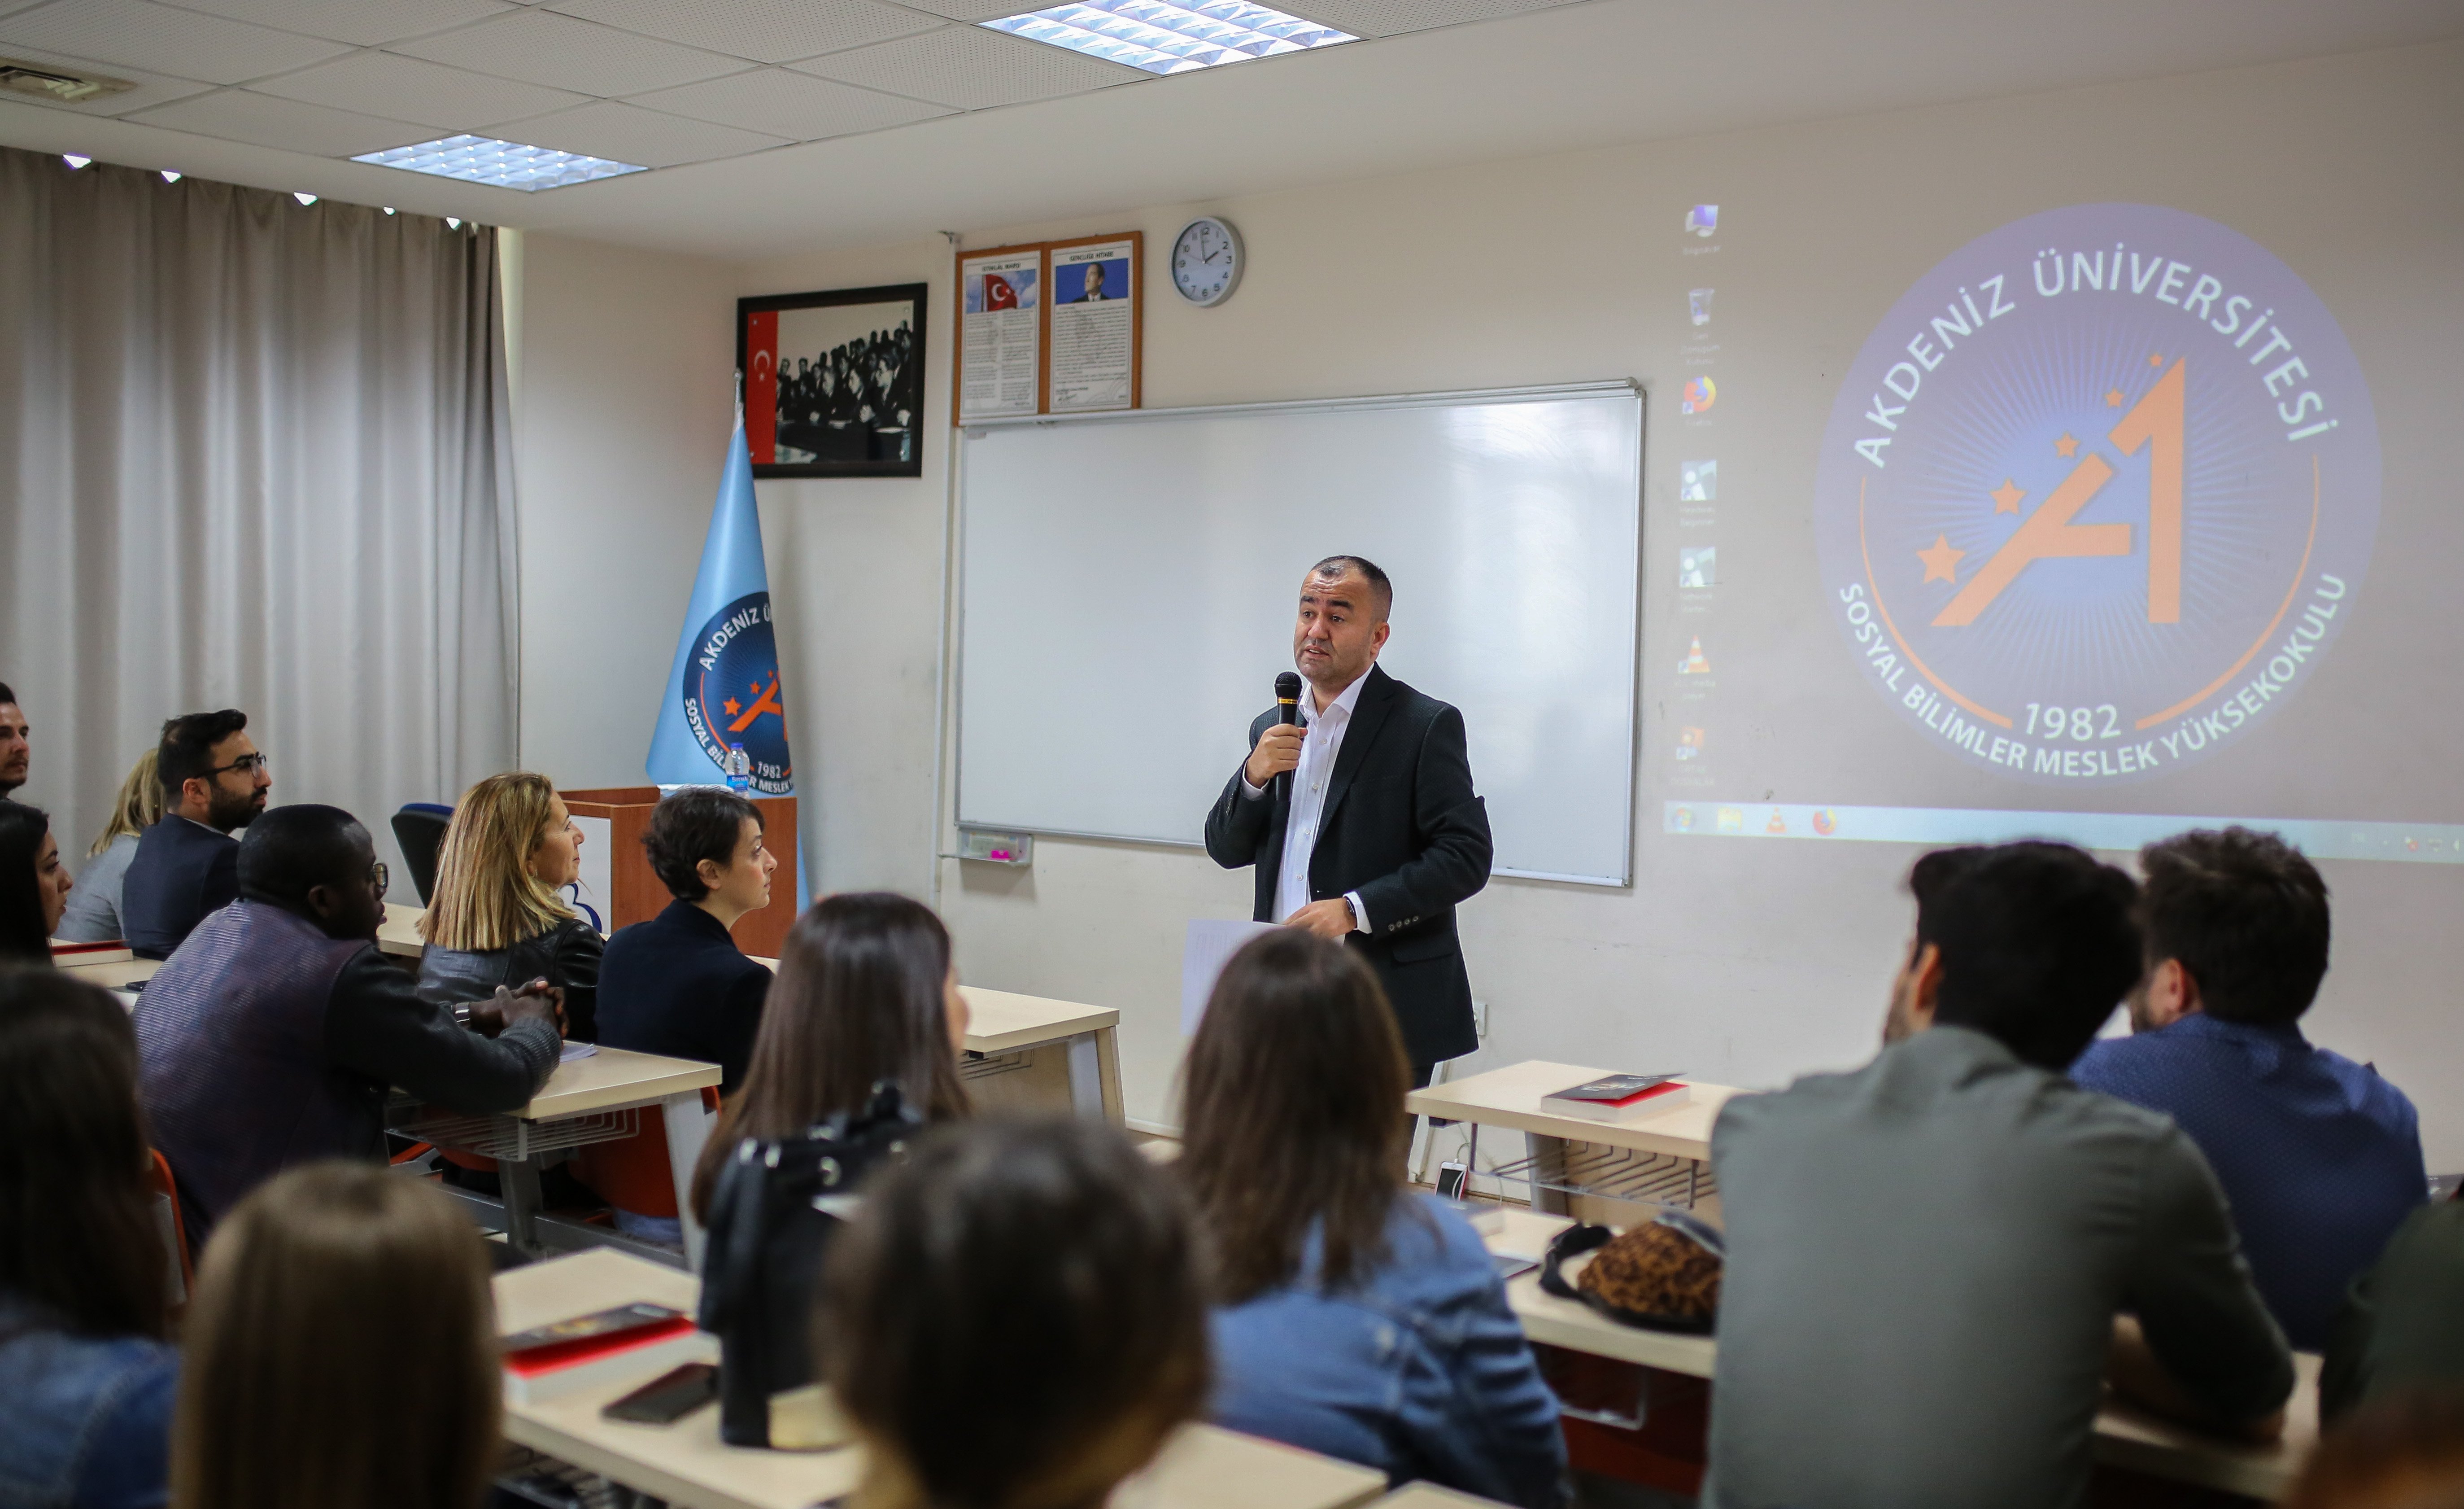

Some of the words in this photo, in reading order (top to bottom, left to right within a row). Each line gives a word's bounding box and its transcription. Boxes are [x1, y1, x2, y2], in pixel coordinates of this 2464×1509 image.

[1853, 273, 2016, 468] AKDENİZ
[2033, 241, 2338, 442] ÜNİVERSİTESİ
[698, 607, 760, 672] AKDENİZ
[1839, 582, 1904, 692] SOSYAL
[1902, 683, 2028, 770] BİLİMLER
[2032, 742, 2159, 777] MESLEK
[2159, 573, 2347, 761] YÜKSEKOKULU
[685, 697, 711, 748] SOSYAL
[759, 779, 789, 793] MESLEK
[2024, 703, 2122, 741] 1982
[757, 761, 781, 779] 1982
